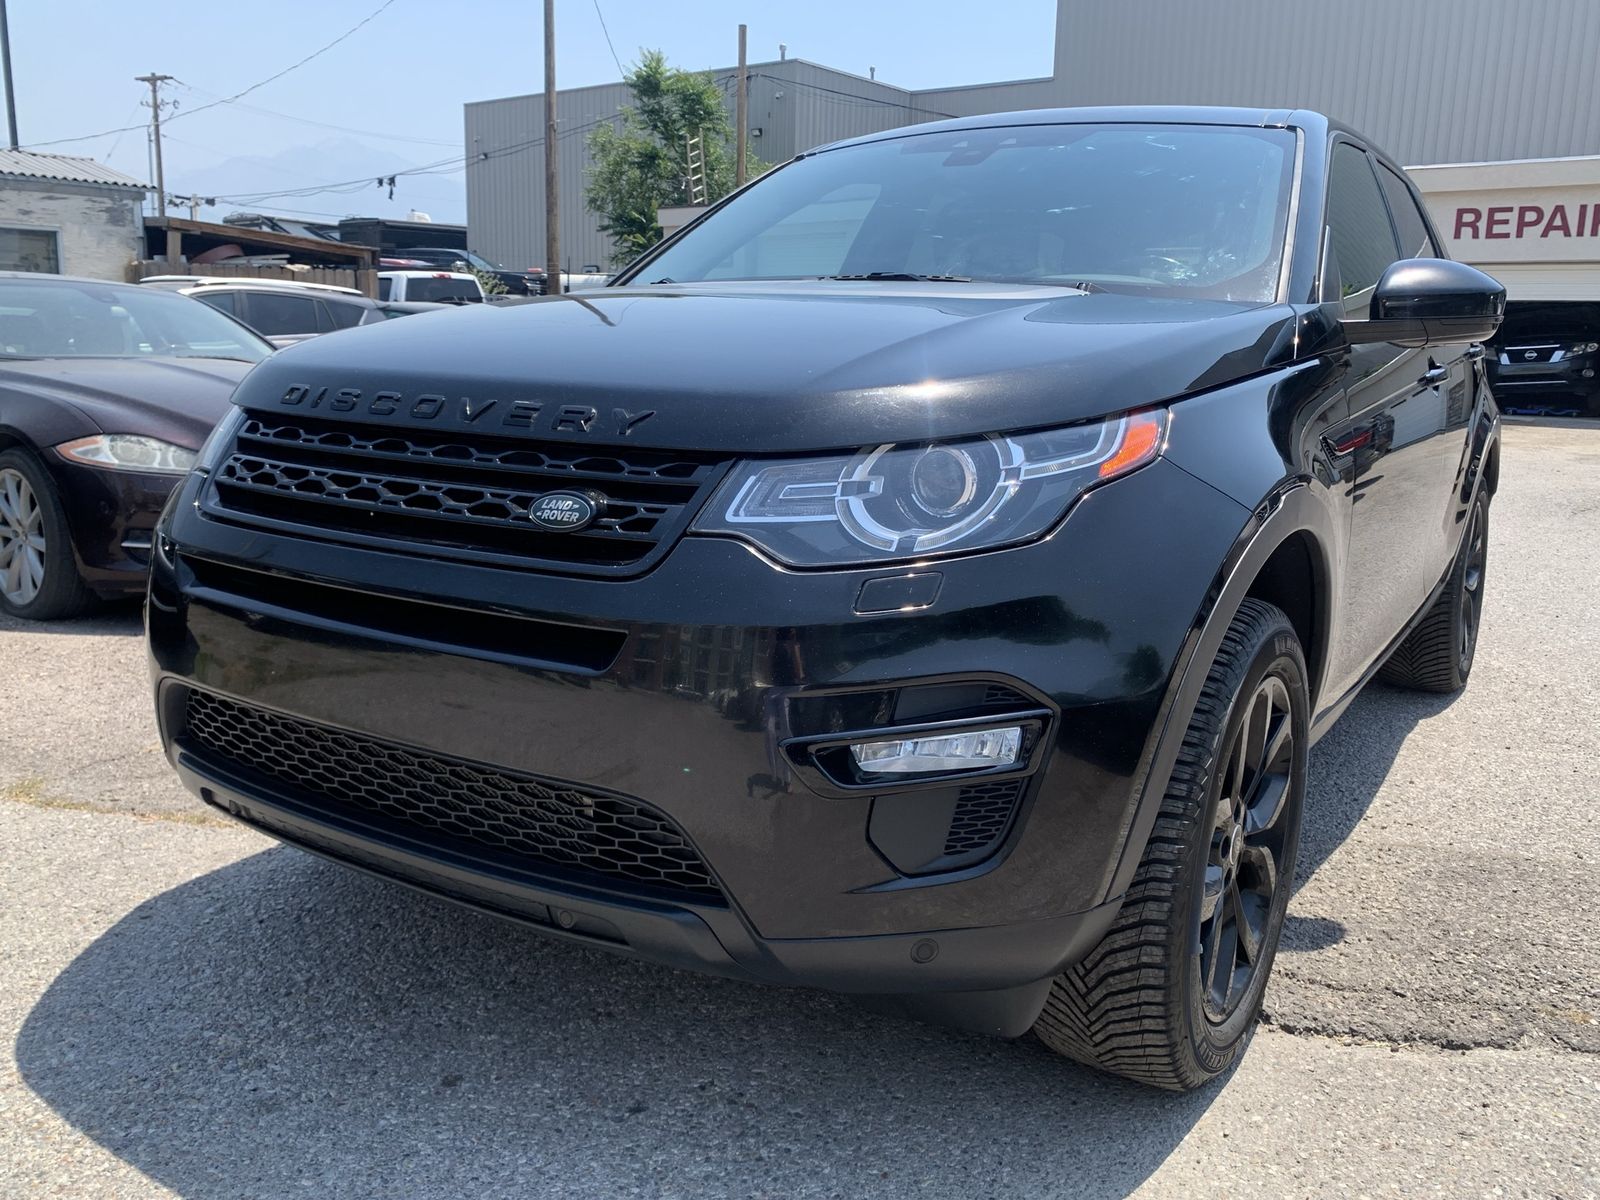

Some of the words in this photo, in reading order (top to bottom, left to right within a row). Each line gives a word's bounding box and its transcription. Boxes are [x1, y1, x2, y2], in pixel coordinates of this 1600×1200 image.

[280, 383, 657, 436] DISCOVERY
[541, 499, 573, 511] LAND
[541, 509, 580, 522] ROVER
